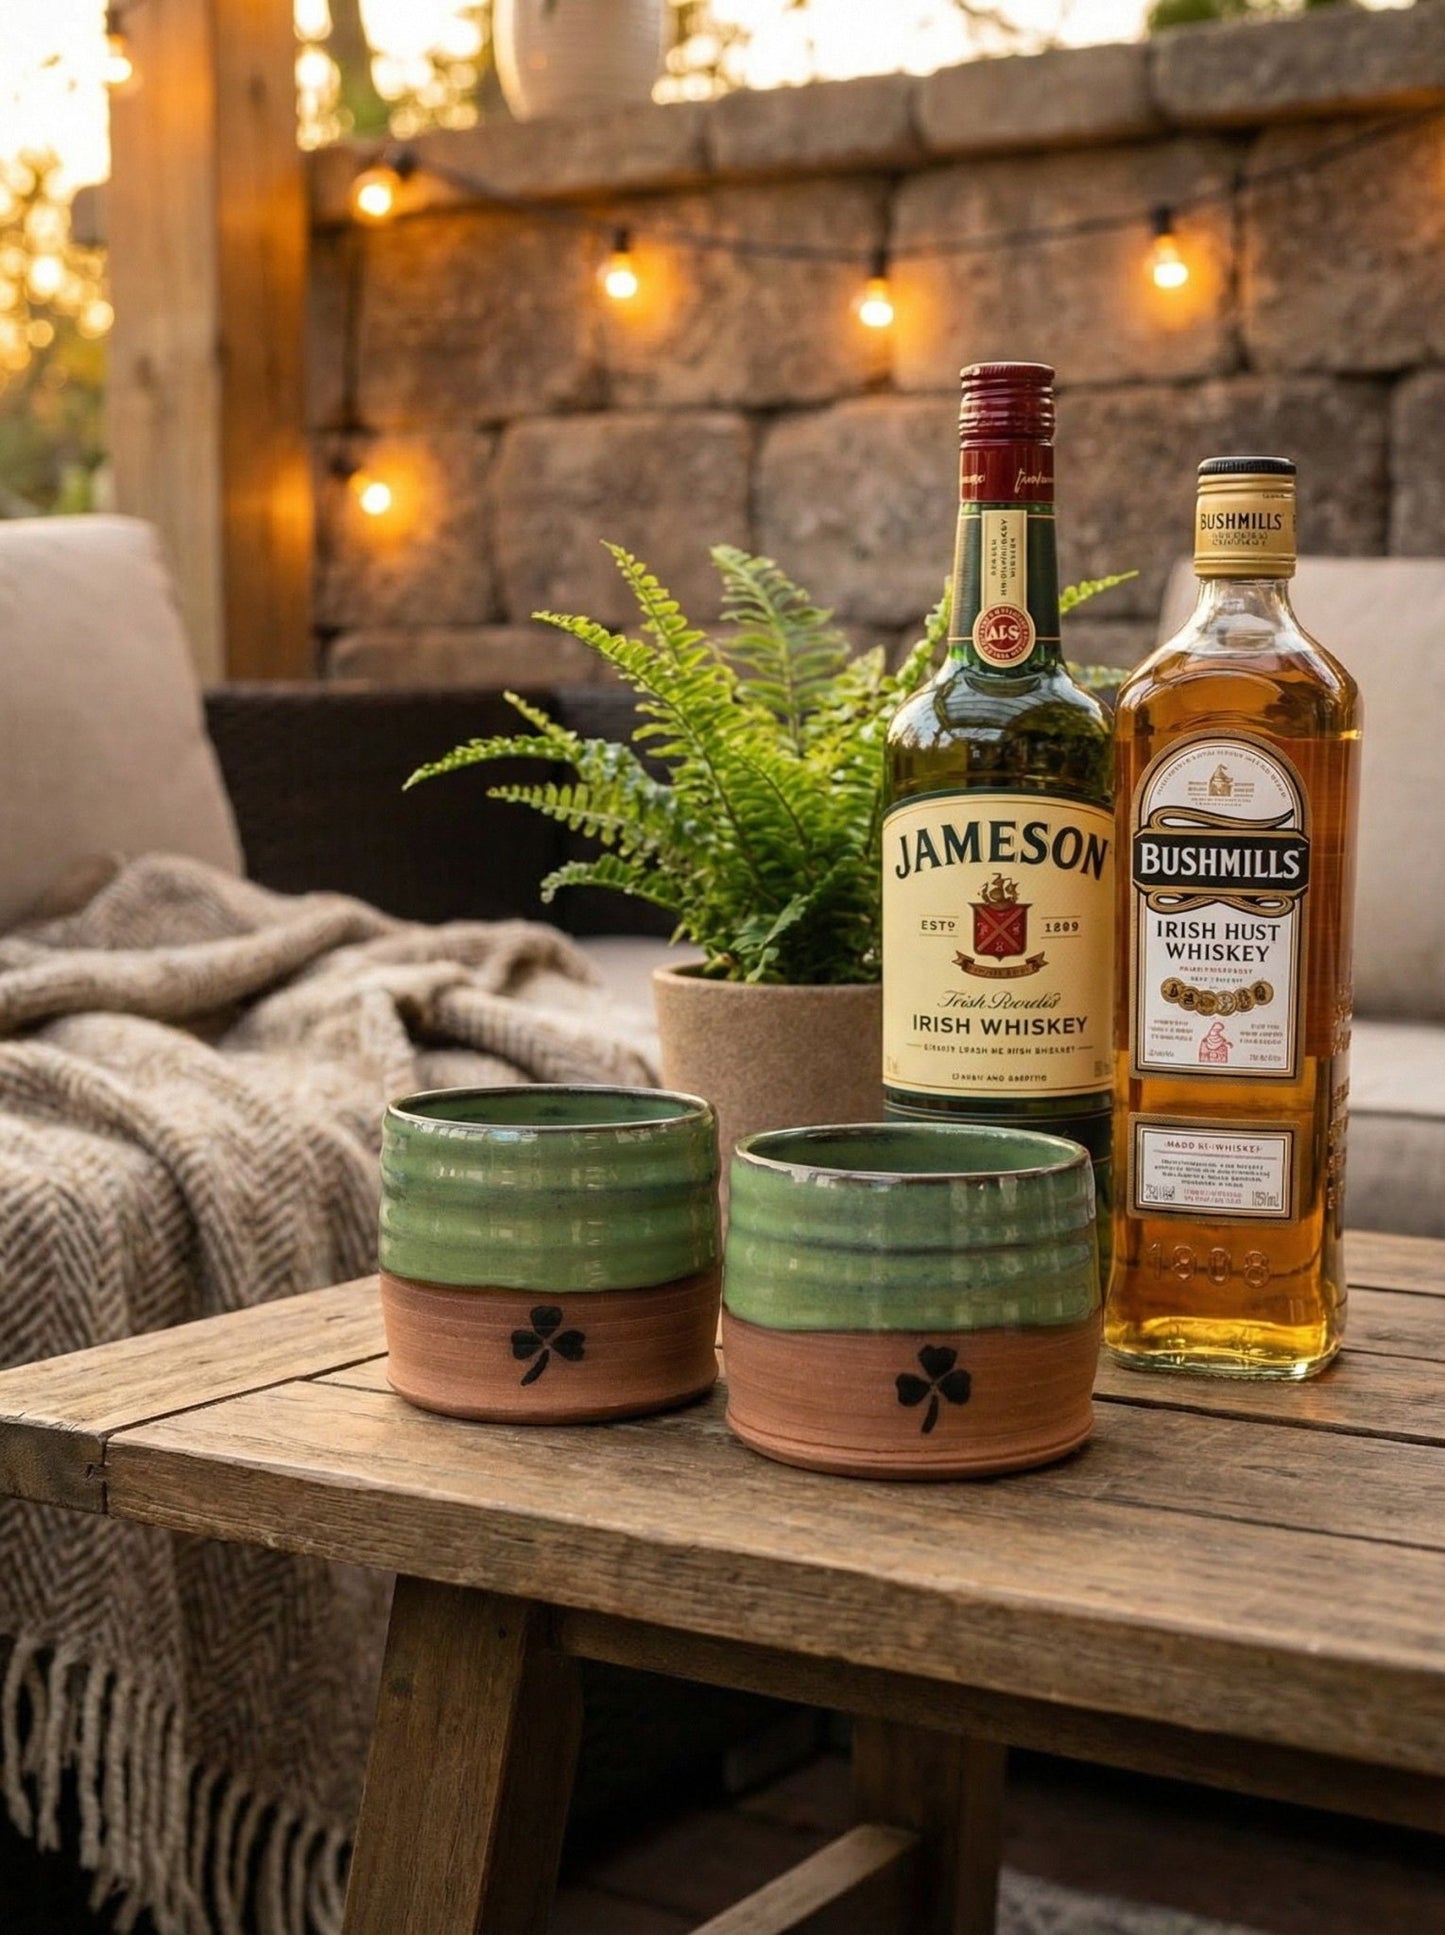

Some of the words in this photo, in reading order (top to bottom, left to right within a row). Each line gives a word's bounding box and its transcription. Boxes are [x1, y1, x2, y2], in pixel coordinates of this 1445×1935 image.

[1200, 512, 1282, 531] BUSHMILLS
[895, 820, 1109, 882] JAMESON
[1140, 842, 1300, 880] BUSHMILLS
[1156, 920, 1216, 940] IRISH
[1225, 923, 1281, 942] HUST
[1166, 942, 1270, 963] WHISKEY
[913, 1014, 971, 1034] IRISH
[981, 1016, 1088, 1036] WHISKEY
